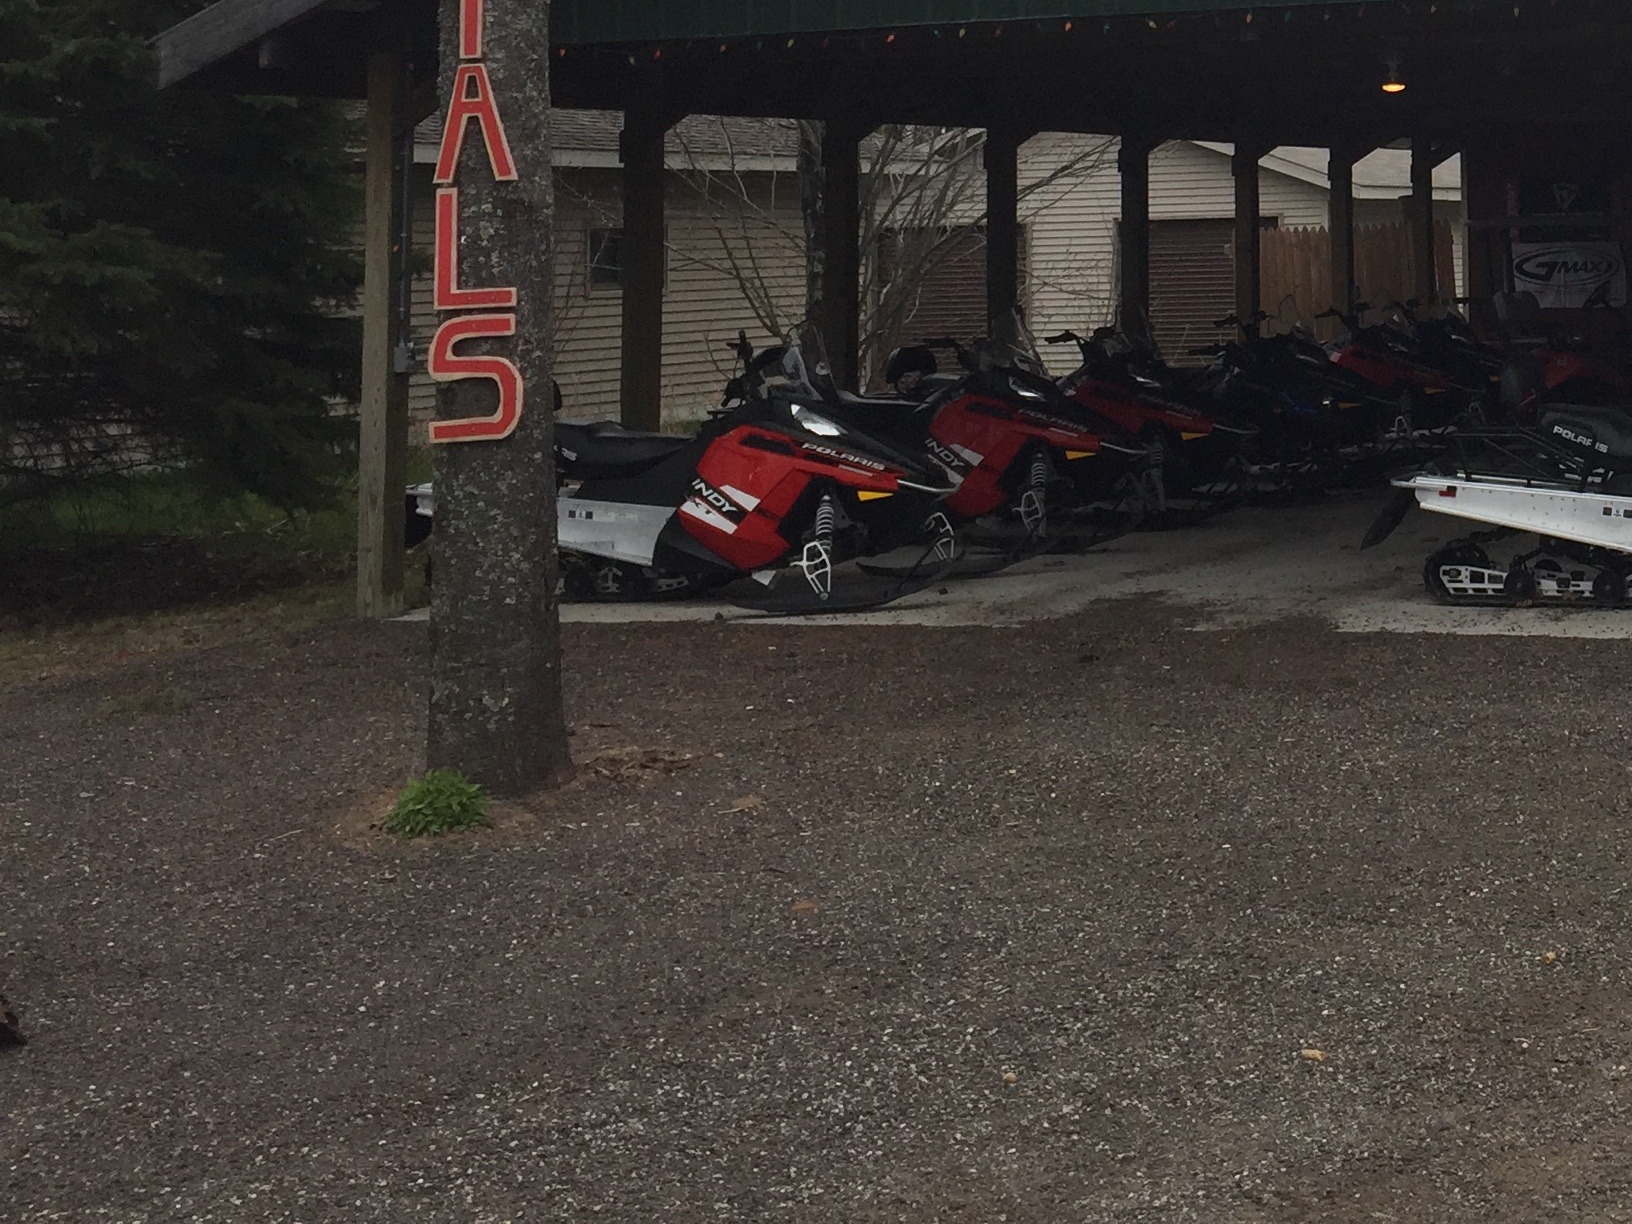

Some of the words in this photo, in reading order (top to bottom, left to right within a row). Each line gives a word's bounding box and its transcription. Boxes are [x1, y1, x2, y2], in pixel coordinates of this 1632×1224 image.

[801, 442, 885, 471] POLARIS
[923, 437, 965, 467] INDY
[691, 478, 739, 513] INDY
